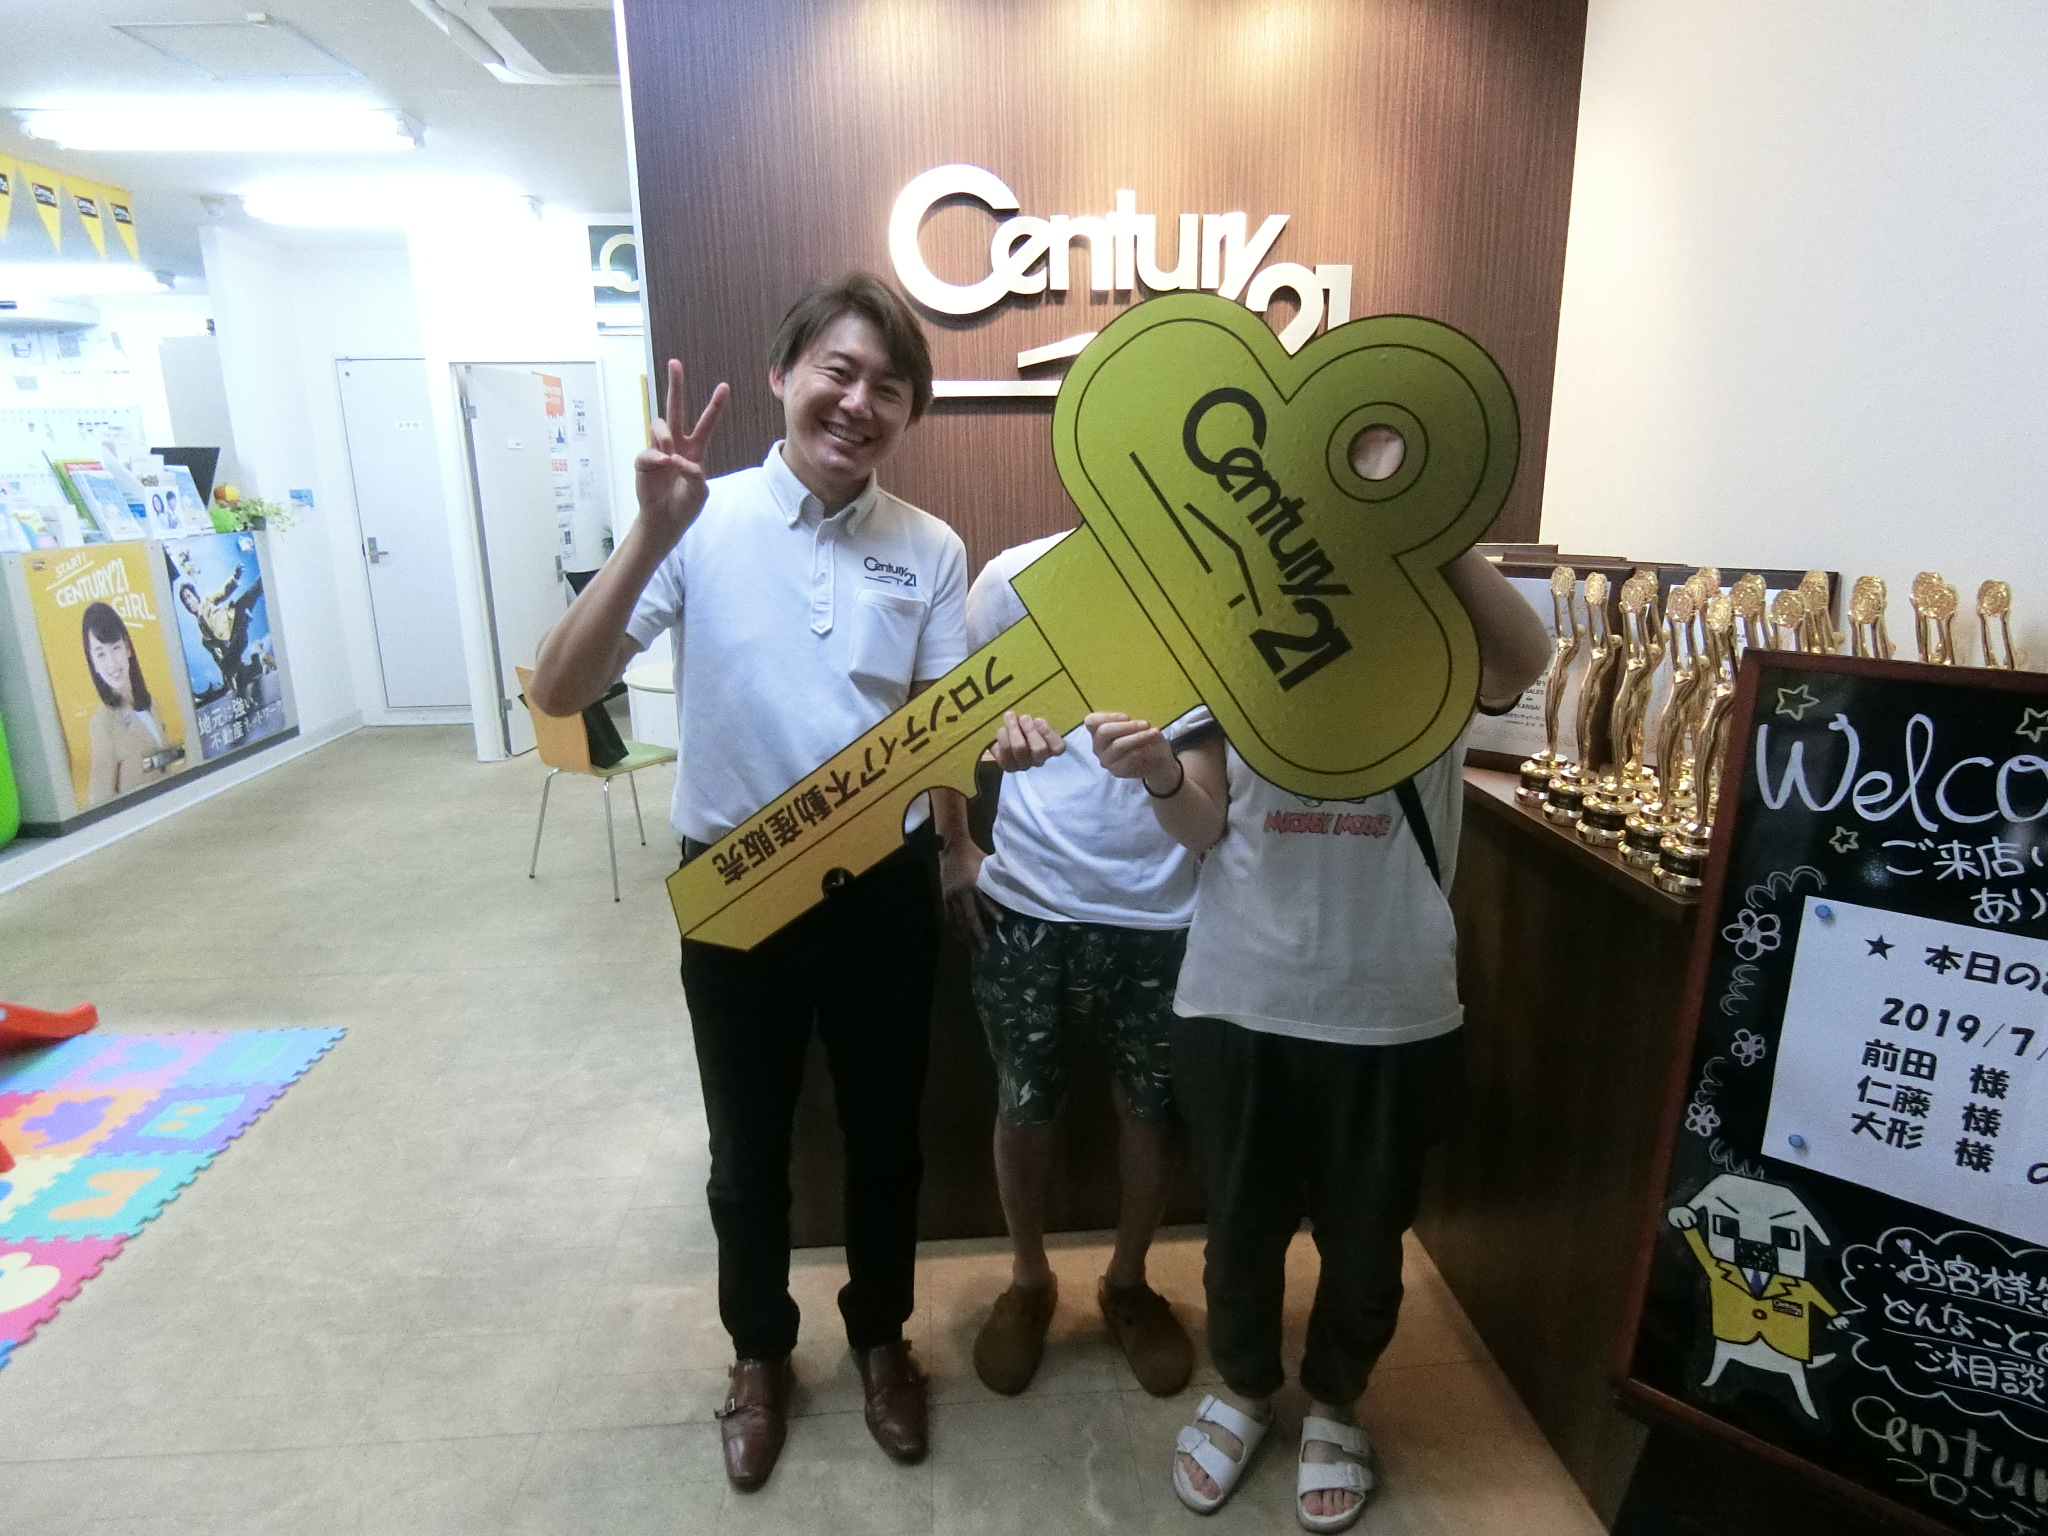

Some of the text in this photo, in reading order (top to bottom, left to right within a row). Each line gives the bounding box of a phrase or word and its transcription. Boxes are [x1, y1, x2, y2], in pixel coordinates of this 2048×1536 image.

[889, 164, 1352, 356] Century 21
[1182, 387, 1353, 692] Century 21
[863, 556, 917, 587] Century 21
[112, 592, 156, 620] GIRL
[711, 656, 1014, 886] フロンティア不動産販売
[1756, 713, 2048, 832] Welco
[1925, 945, 2048, 996] 本日の
[1862, 1039, 2010, 1100] 前田 様
[1857, 1075, 2003, 1138] 仁藤 様
[1851, 1110, 1926, 1150] 大形
[1955, 1137, 1995, 1172] 様
